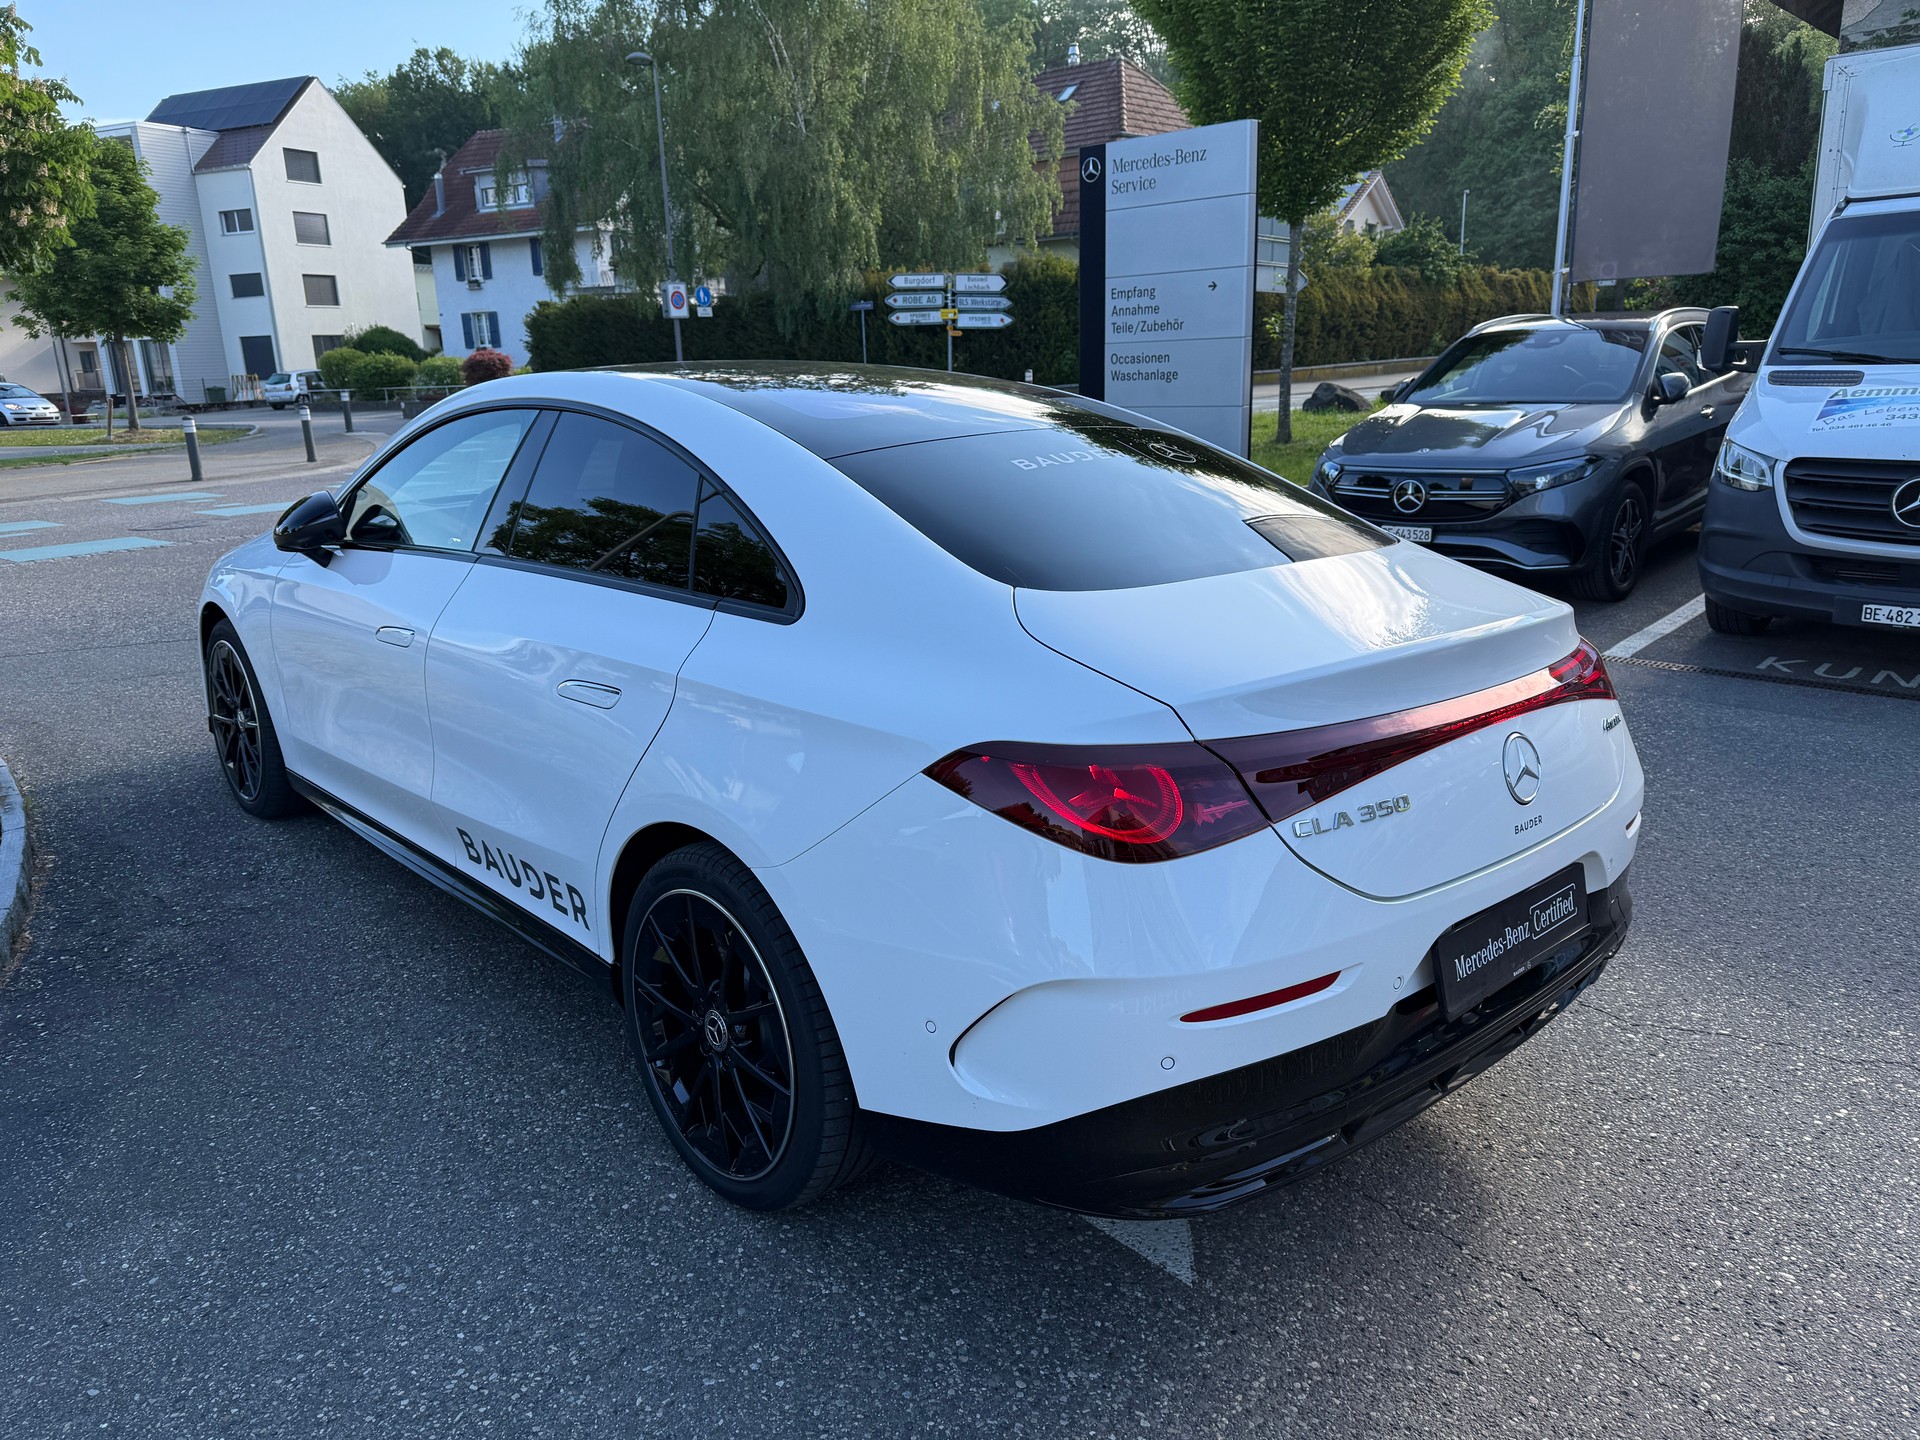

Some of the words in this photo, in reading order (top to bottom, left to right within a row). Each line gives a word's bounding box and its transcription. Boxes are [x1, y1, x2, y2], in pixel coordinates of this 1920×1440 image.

[1112, 148, 1207, 175] Mercedes-Benz
[1111, 176, 1157, 195] Service
[904, 276, 935, 287] Burgdorf
[902, 296, 924, 304] ROBE
[926, 296, 937, 304] AG
[1111, 286, 1156, 302] Empfang
[1111, 303, 1160, 317] Annahme
[1111, 318, 1185, 336] Teile/Zubehör
[1111, 352, 1170, 365] Occasionen
[1111, 369, 1179, 384] Waschanlage
[1828, 387, 1920, 400] Aemm
[1823, 412, 1855, 425] Das
[1864, 405, 1920, 416] Leben
[1010, 448, 1127, 471] BAUDER
[1755, 656, 1920, 689] KUN
[1291, 811, 1355, 838] CLA
[1357, 793, 1411, 823] 350
[1514, 814, 1543, 835] BAUDER
[456, 826, 591, 931] BAUDER
[1454, 920, 1531, 982] Mercedes-Benz
[1533, 890, 1575, 932] Certified
